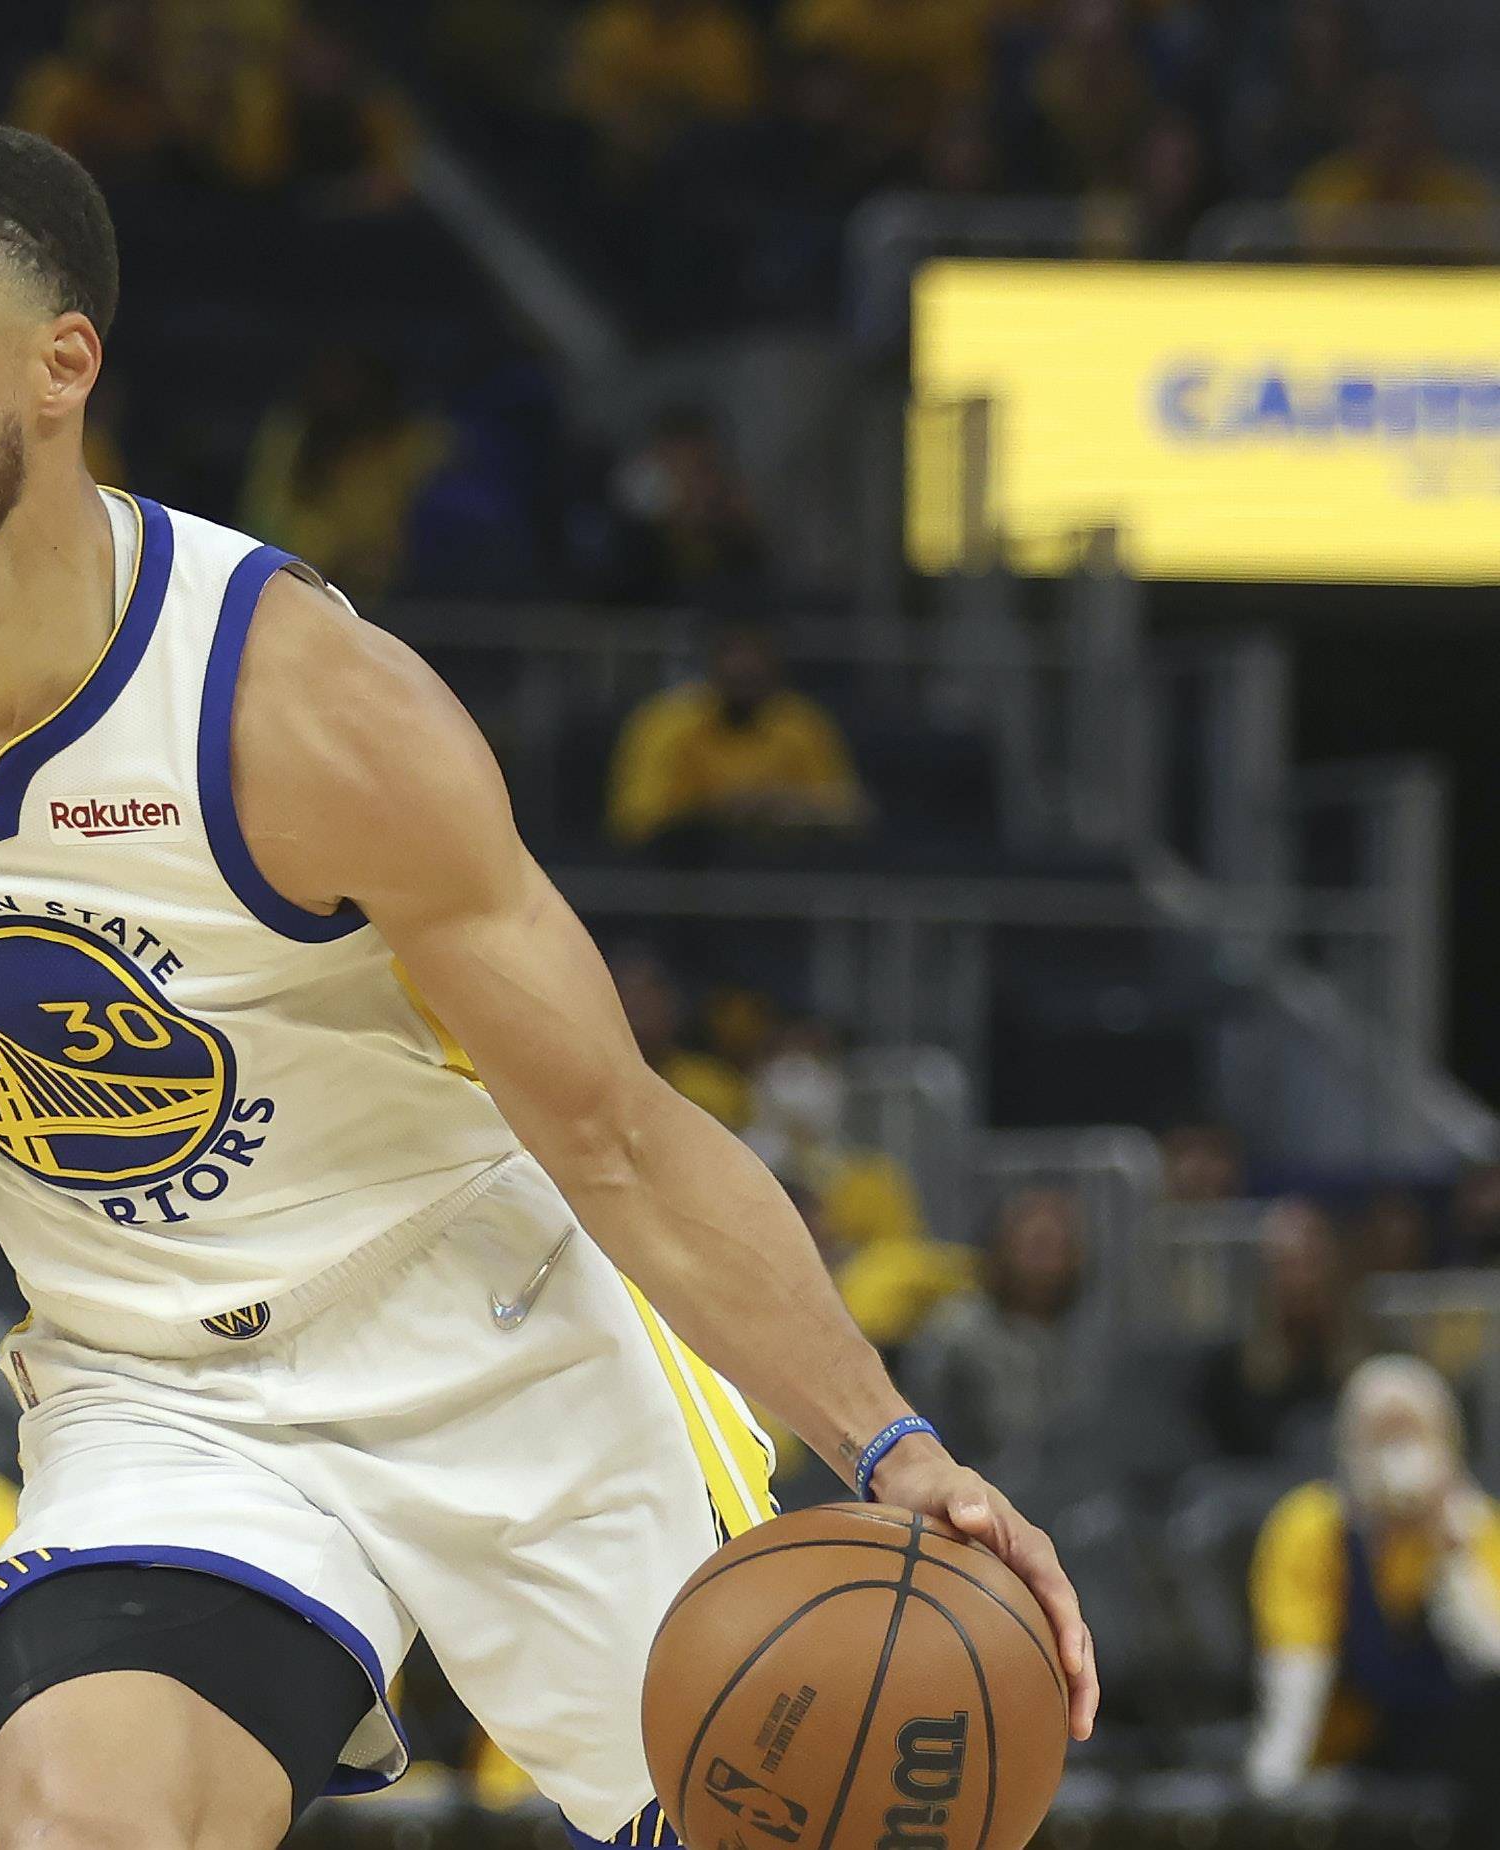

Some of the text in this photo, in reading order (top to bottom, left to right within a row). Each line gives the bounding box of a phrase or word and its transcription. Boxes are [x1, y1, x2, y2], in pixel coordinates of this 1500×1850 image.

[50, 799, 181, 829] Rakuten
[44, 900, 184, 986] STATE
[38, 1001, 172, 1063] 30
